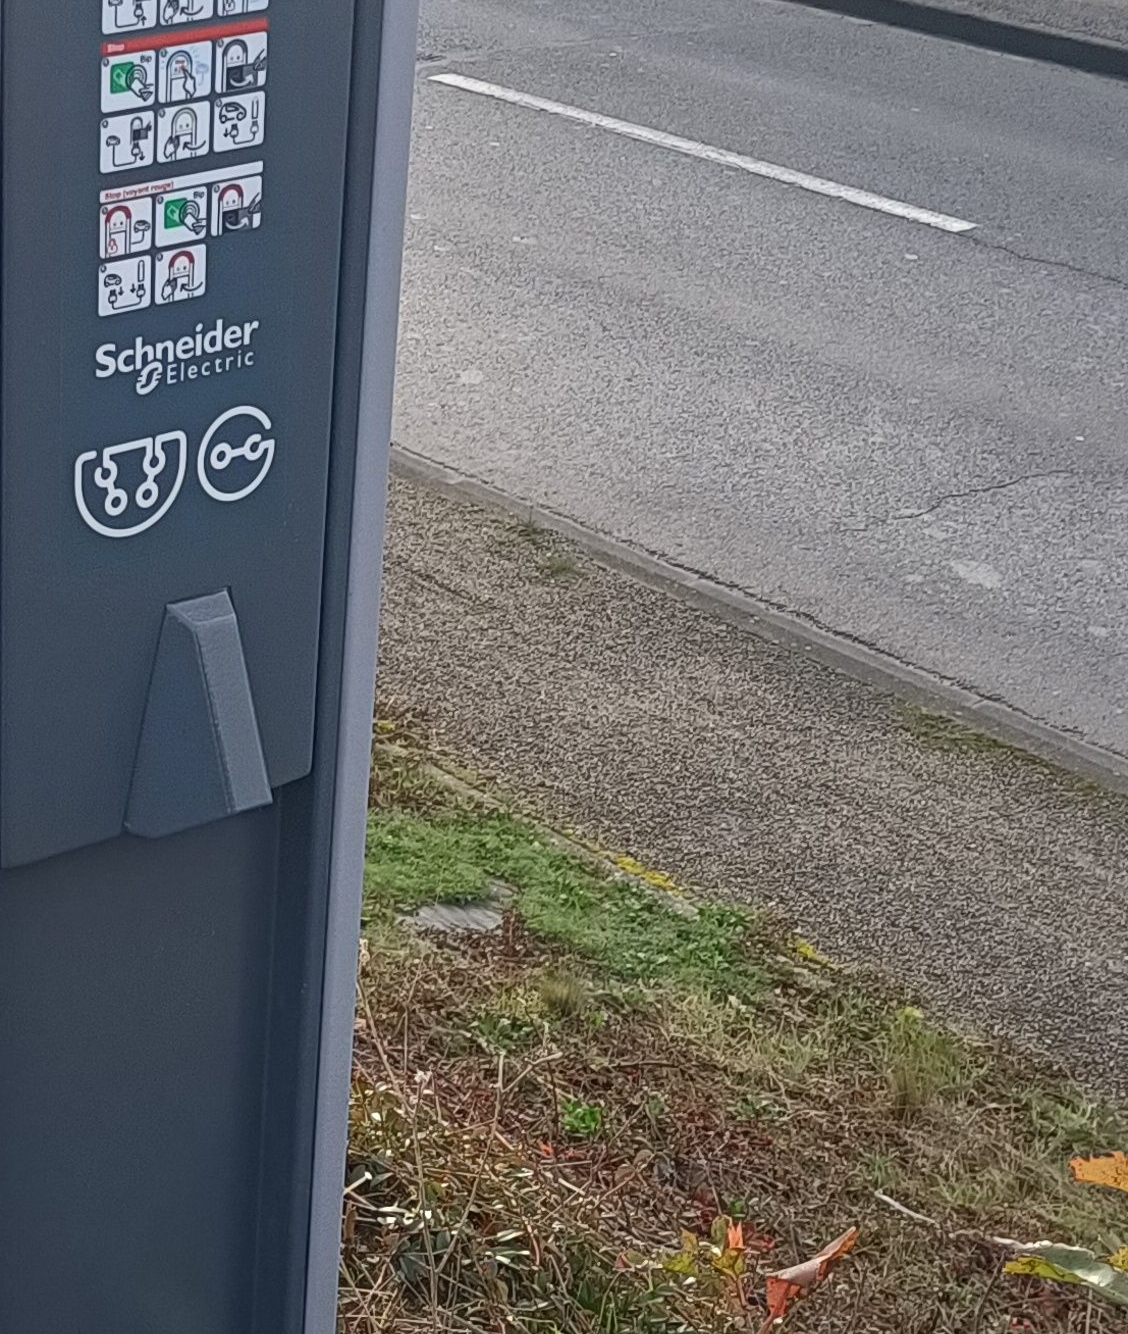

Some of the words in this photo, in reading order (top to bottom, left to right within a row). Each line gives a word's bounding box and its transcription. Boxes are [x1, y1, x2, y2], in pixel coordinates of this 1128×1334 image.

[140, 55, 153, 63] Bip
[104, 188, 121, 200] Stop
[193, 190, 205, 199] Bip
[95, 319, 260, 378] Schneider
[166, 350, 255, 385] Electric
